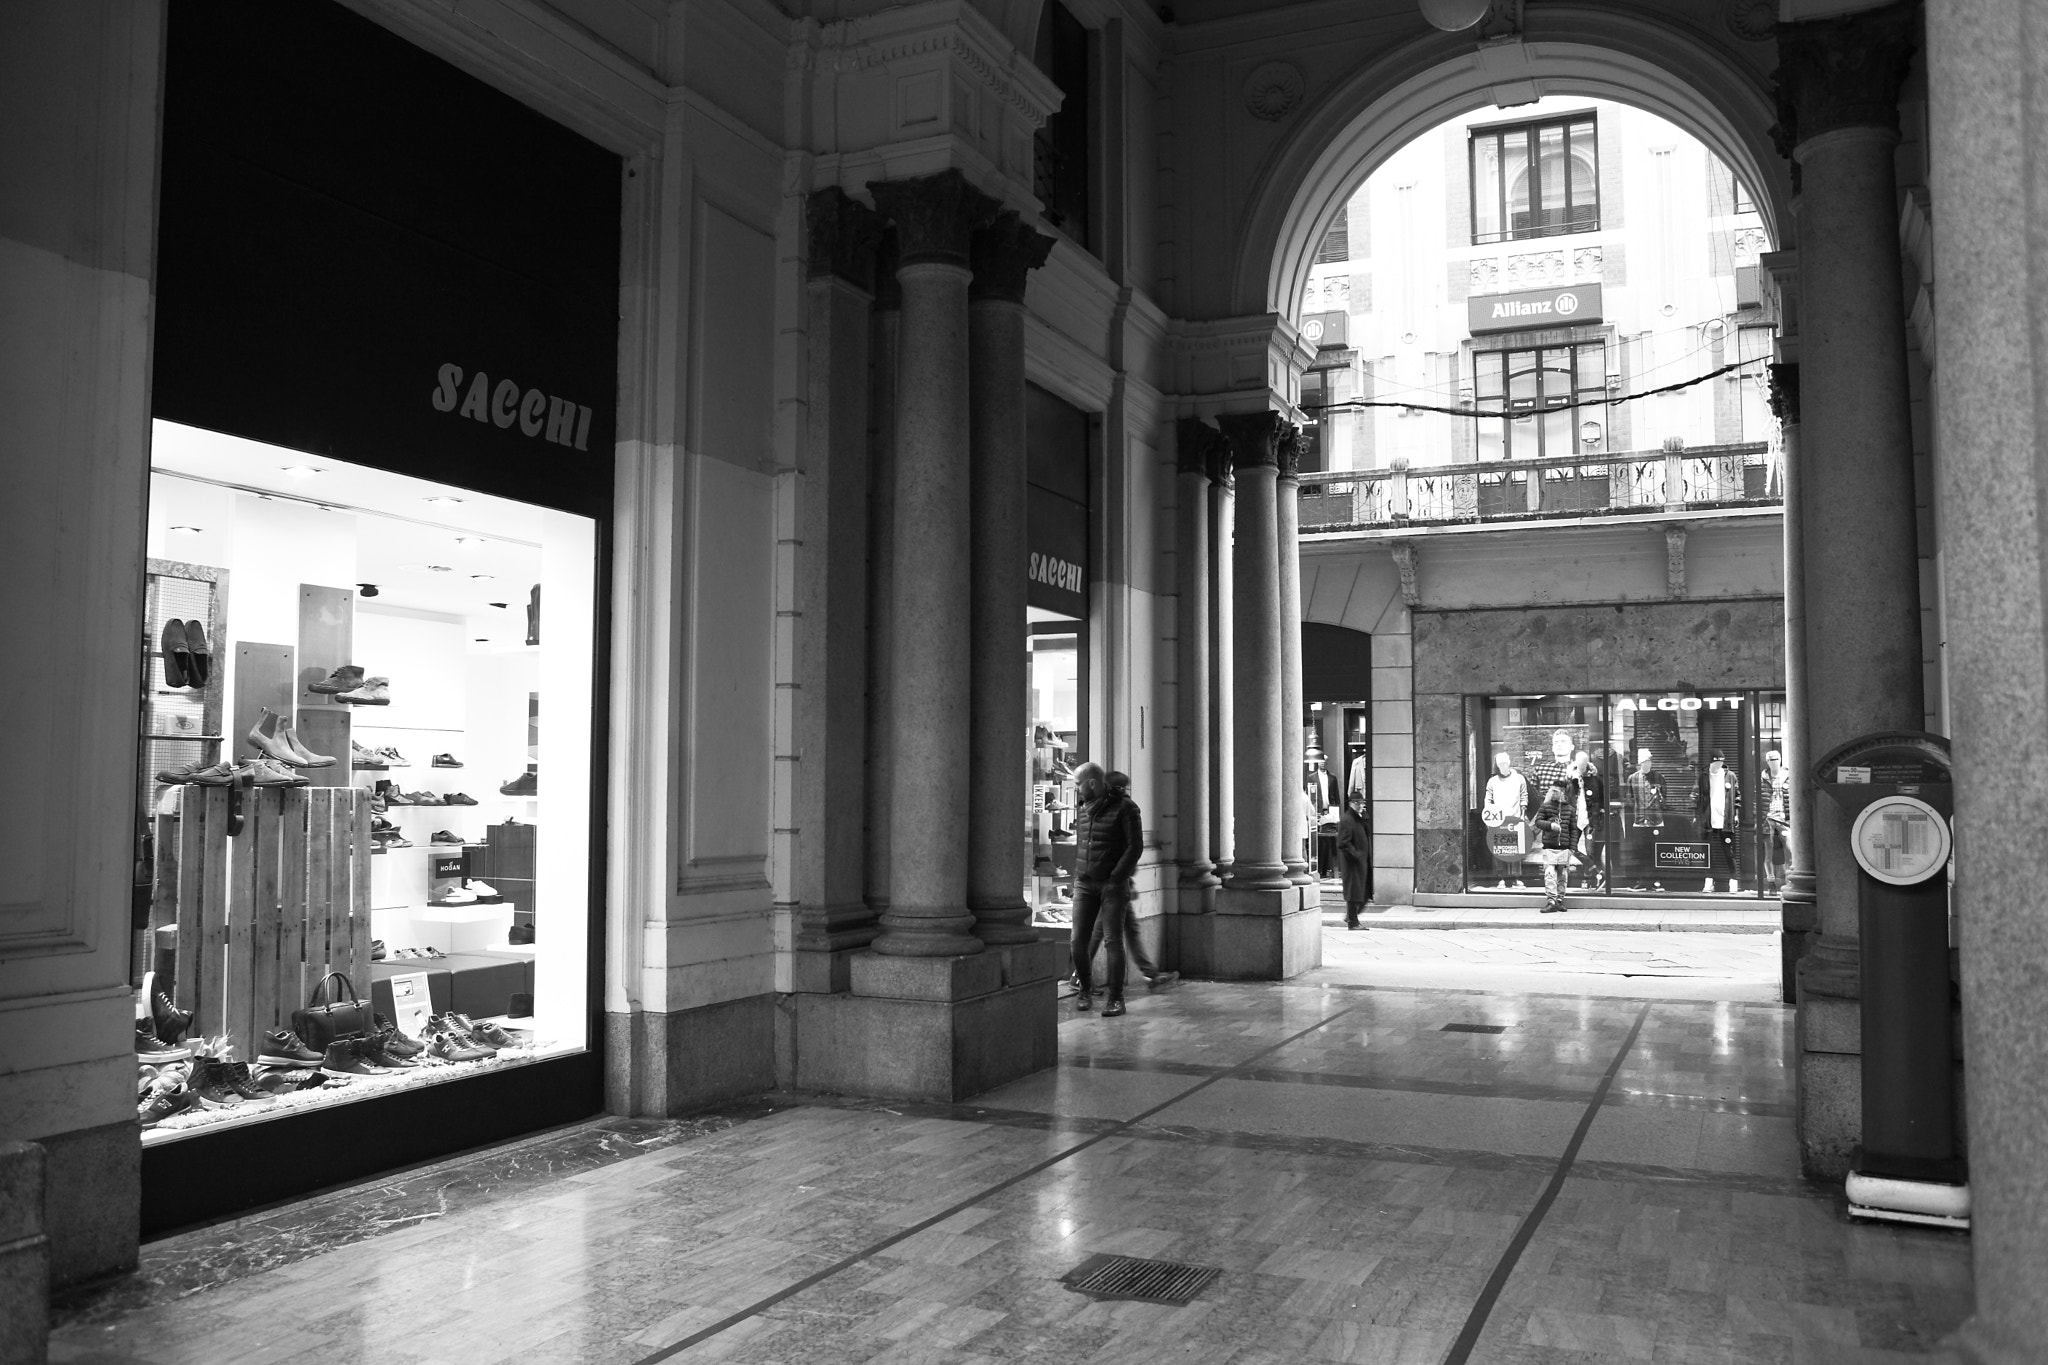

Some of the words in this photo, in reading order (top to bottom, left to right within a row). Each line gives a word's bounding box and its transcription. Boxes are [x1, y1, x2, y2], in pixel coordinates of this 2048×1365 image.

[1491, 300, 1552, 318] Allianz
[432, 362, 592, 452] SACCHI
[1028, 552, 1082, 594] SACCHI
[1616, 696, 1744, 710] ALCOTT
[1484, 810, 1503, 821] 2x1
[440, 862, 461, 872] HOGAN
